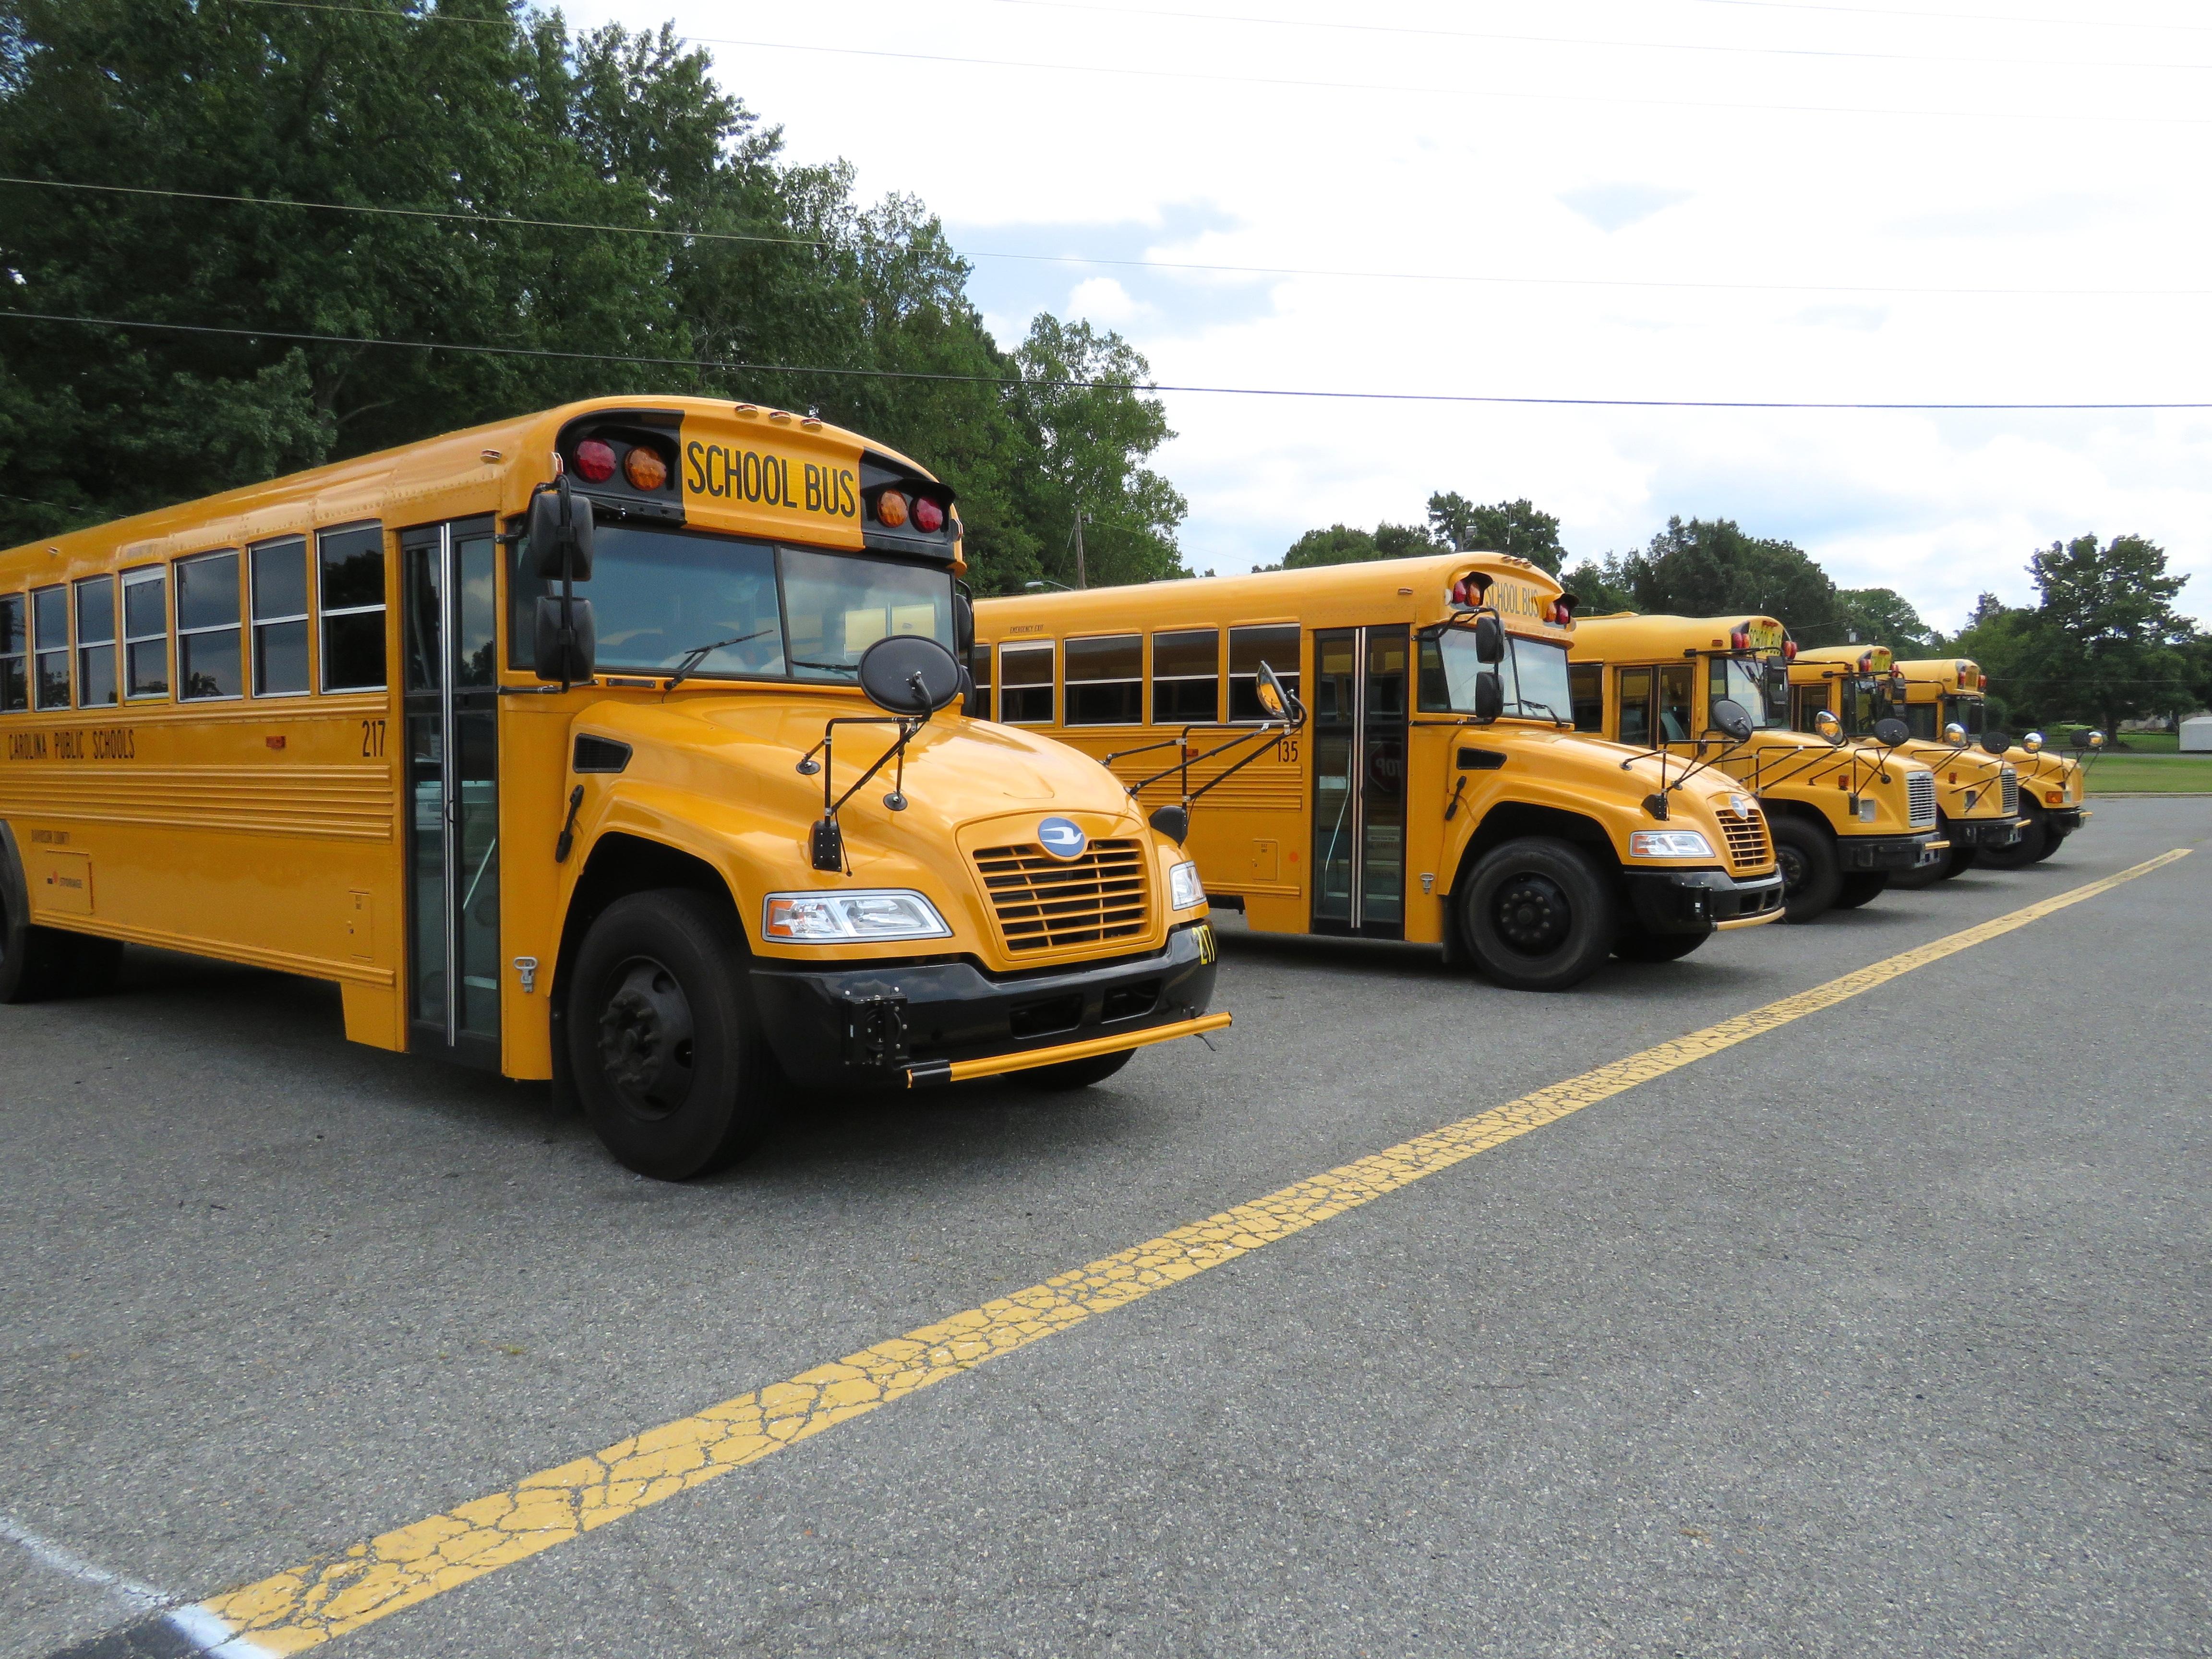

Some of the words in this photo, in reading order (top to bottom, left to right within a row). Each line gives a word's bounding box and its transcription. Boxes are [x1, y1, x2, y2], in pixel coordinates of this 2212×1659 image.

[687, 441, 797, 509] SCHOOL
[804, 463, 856, 518] BUS
[1486, 581, 1520, 614] SCHOOL
[1522, 587, 1539, 618] BUS
[54, 731, 84, 759] PUBLIC
[93, 728, 135, 759] SCHOOLS
[362, 720, 385, 757] 217
[1277, 740, 1298, 762] 135
[1191, 925, 1215, 965] 217
